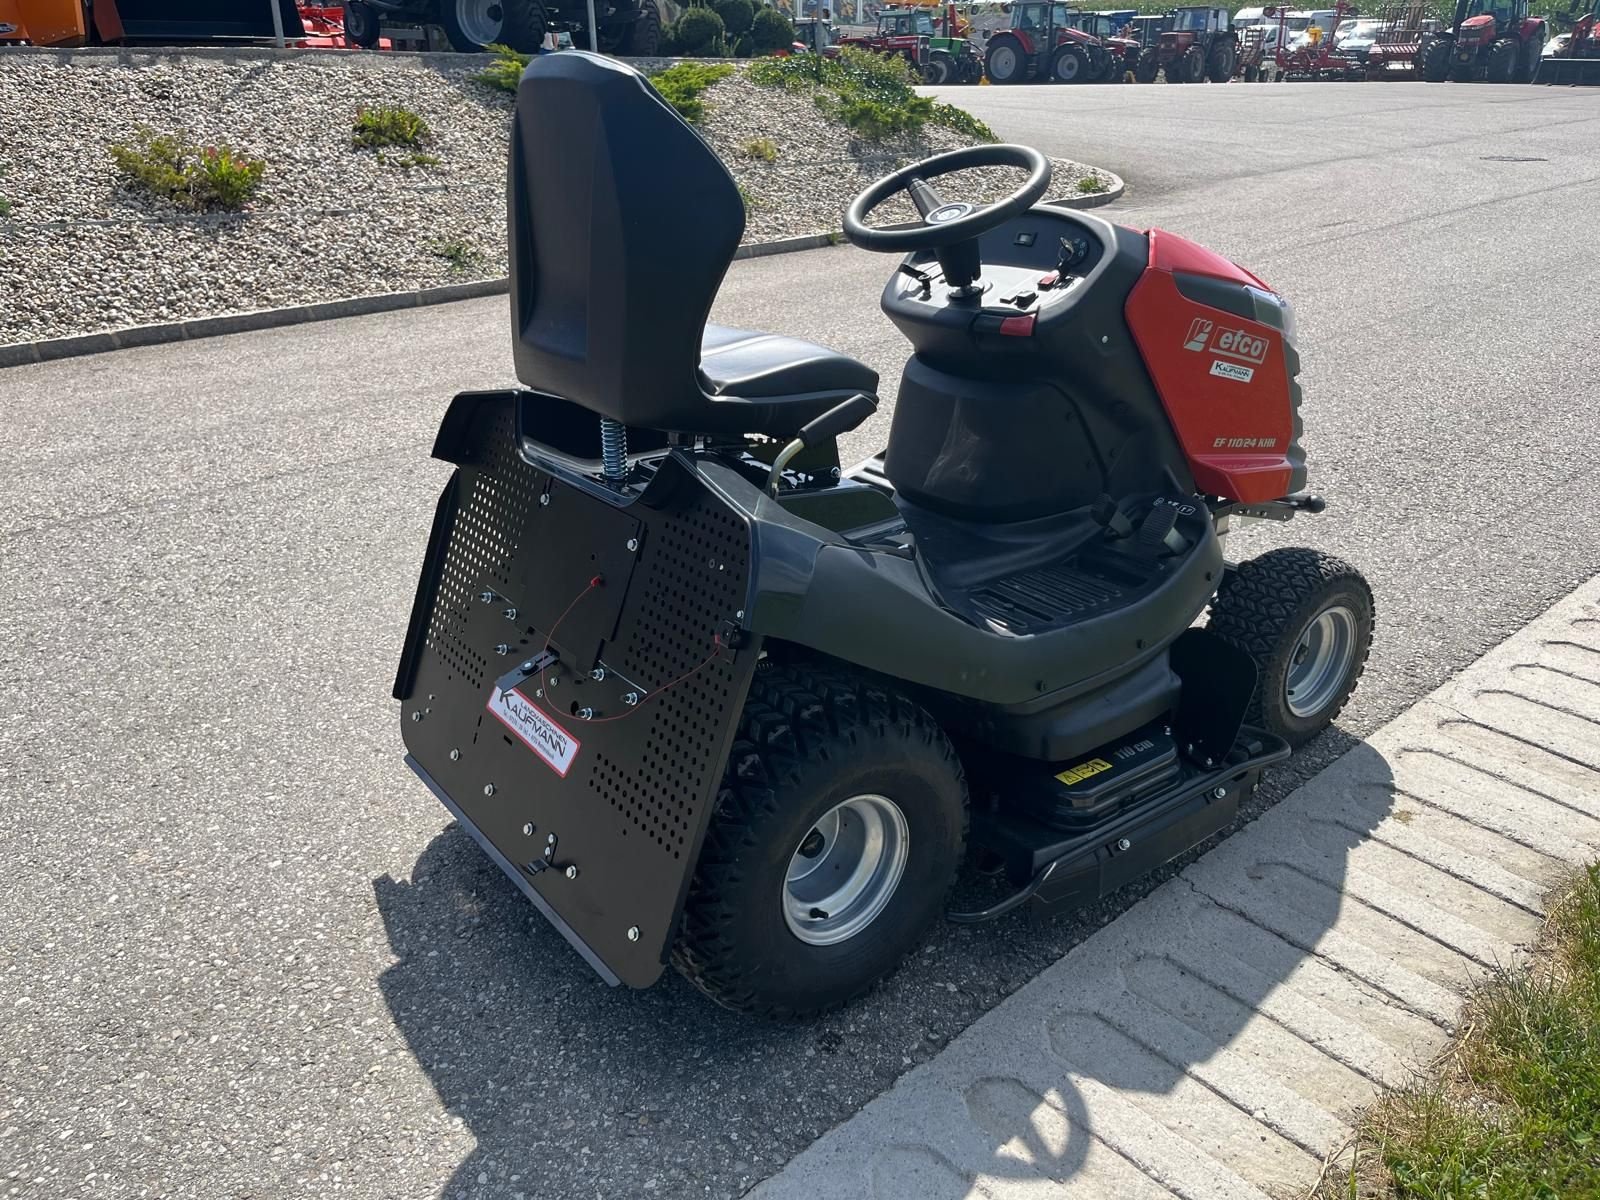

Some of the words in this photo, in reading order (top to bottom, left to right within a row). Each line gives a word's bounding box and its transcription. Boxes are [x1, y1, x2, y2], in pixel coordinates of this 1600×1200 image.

[1220, 330, 1261, 356] efco
[1214, 438, 1225, 447] EF
[1227, 438, 1257, 448] 110/24
[499, 691, 566, 758] KAUFMANN
[1114, 745, 1136, 760] 110
[1133, 739, 1154, 752] cm
